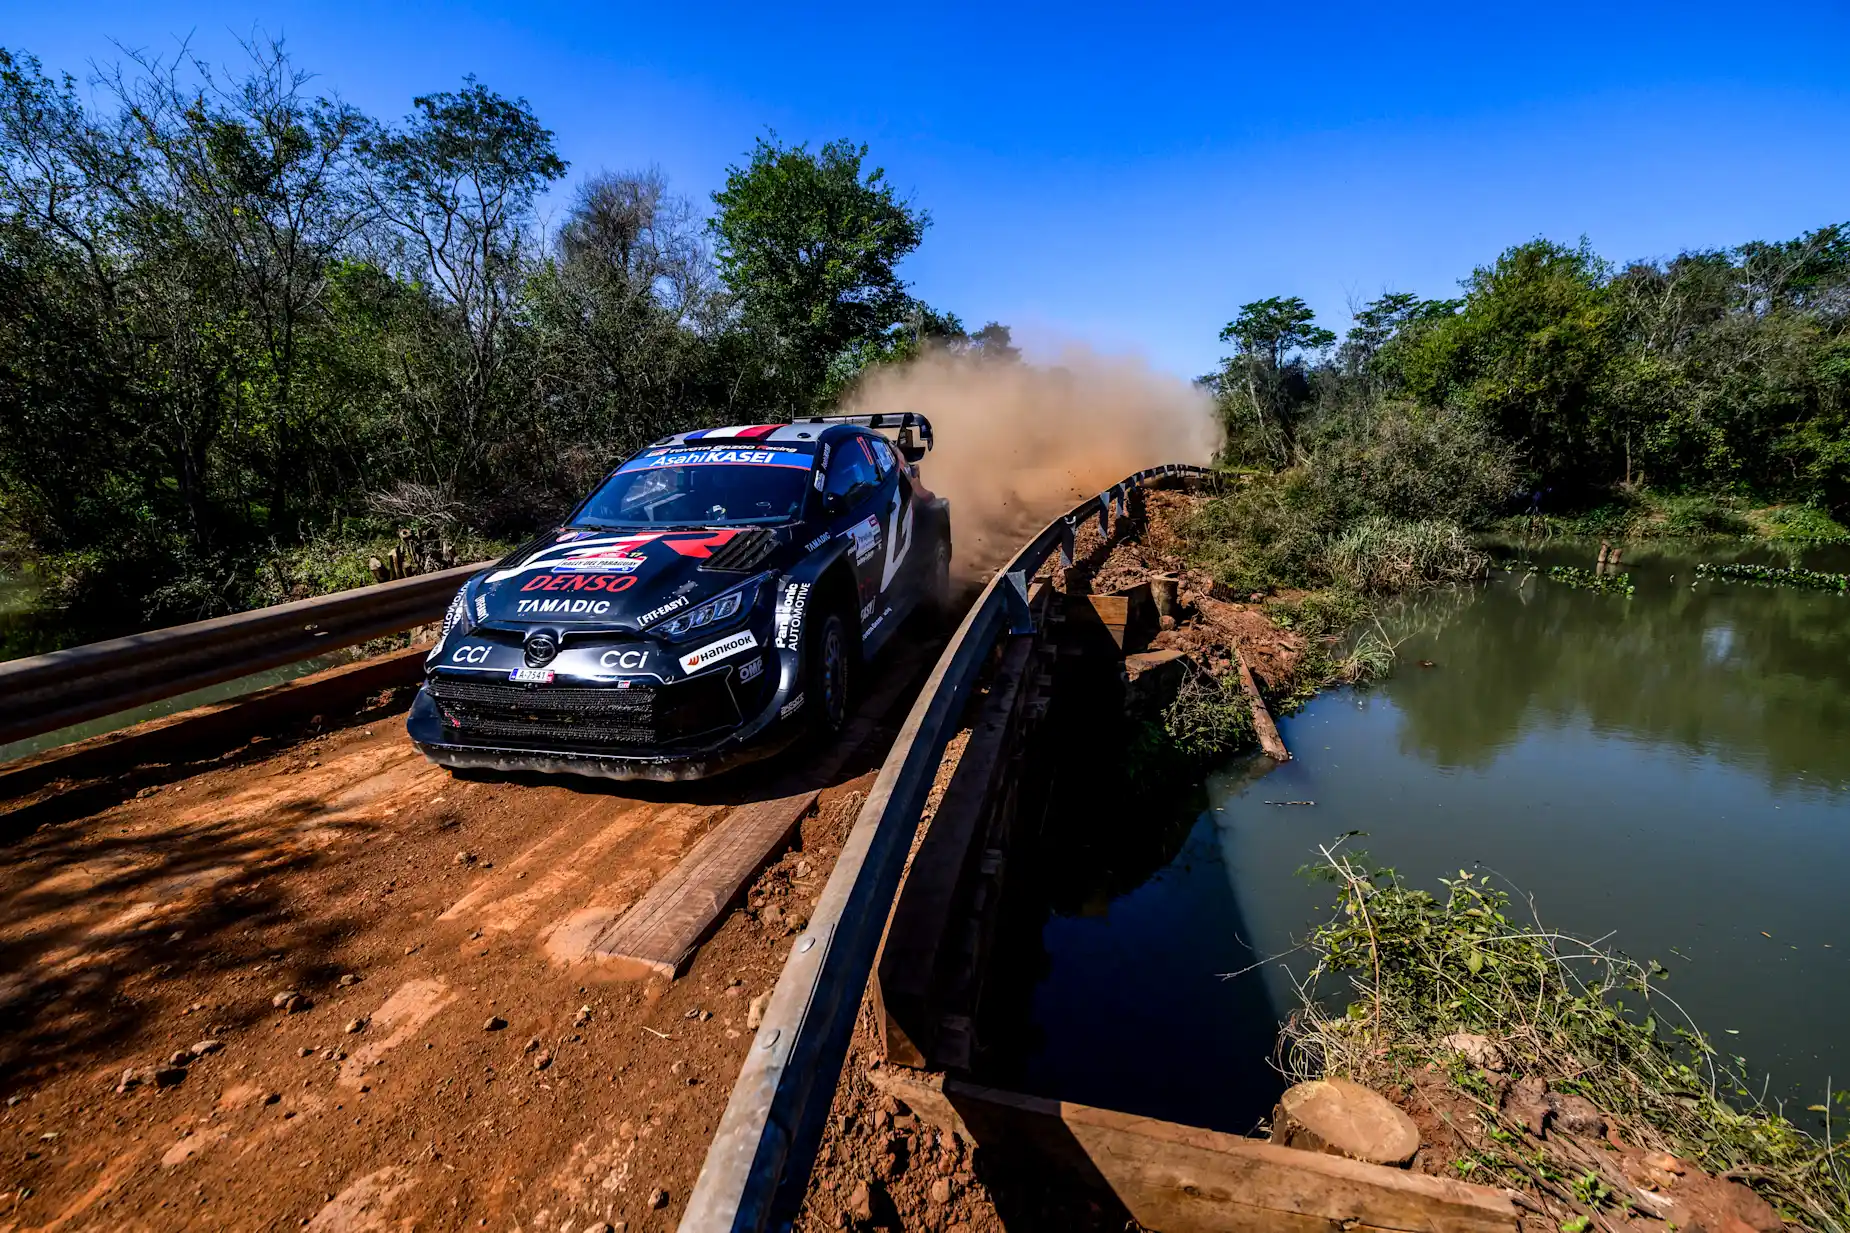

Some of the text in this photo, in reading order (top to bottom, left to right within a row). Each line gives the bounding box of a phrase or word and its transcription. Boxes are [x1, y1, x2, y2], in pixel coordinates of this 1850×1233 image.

[669, 445, 711, 454] TOYOTA
[710, 444, 755, 452] GAZOO
[756, 444, 798, 453] Racing
[804, 531, 831, 553] TAMADIC
[520, 574, 638, 592] DENSO
[516, 599, 611, 614] TAMADIC
[775, 583, 799, 648] Panonic
[788, 582, 811, 652] AUTOMOTIVE
[518, 671, 546, 680] A-7541
[740, 659, 763, 680] OMP
